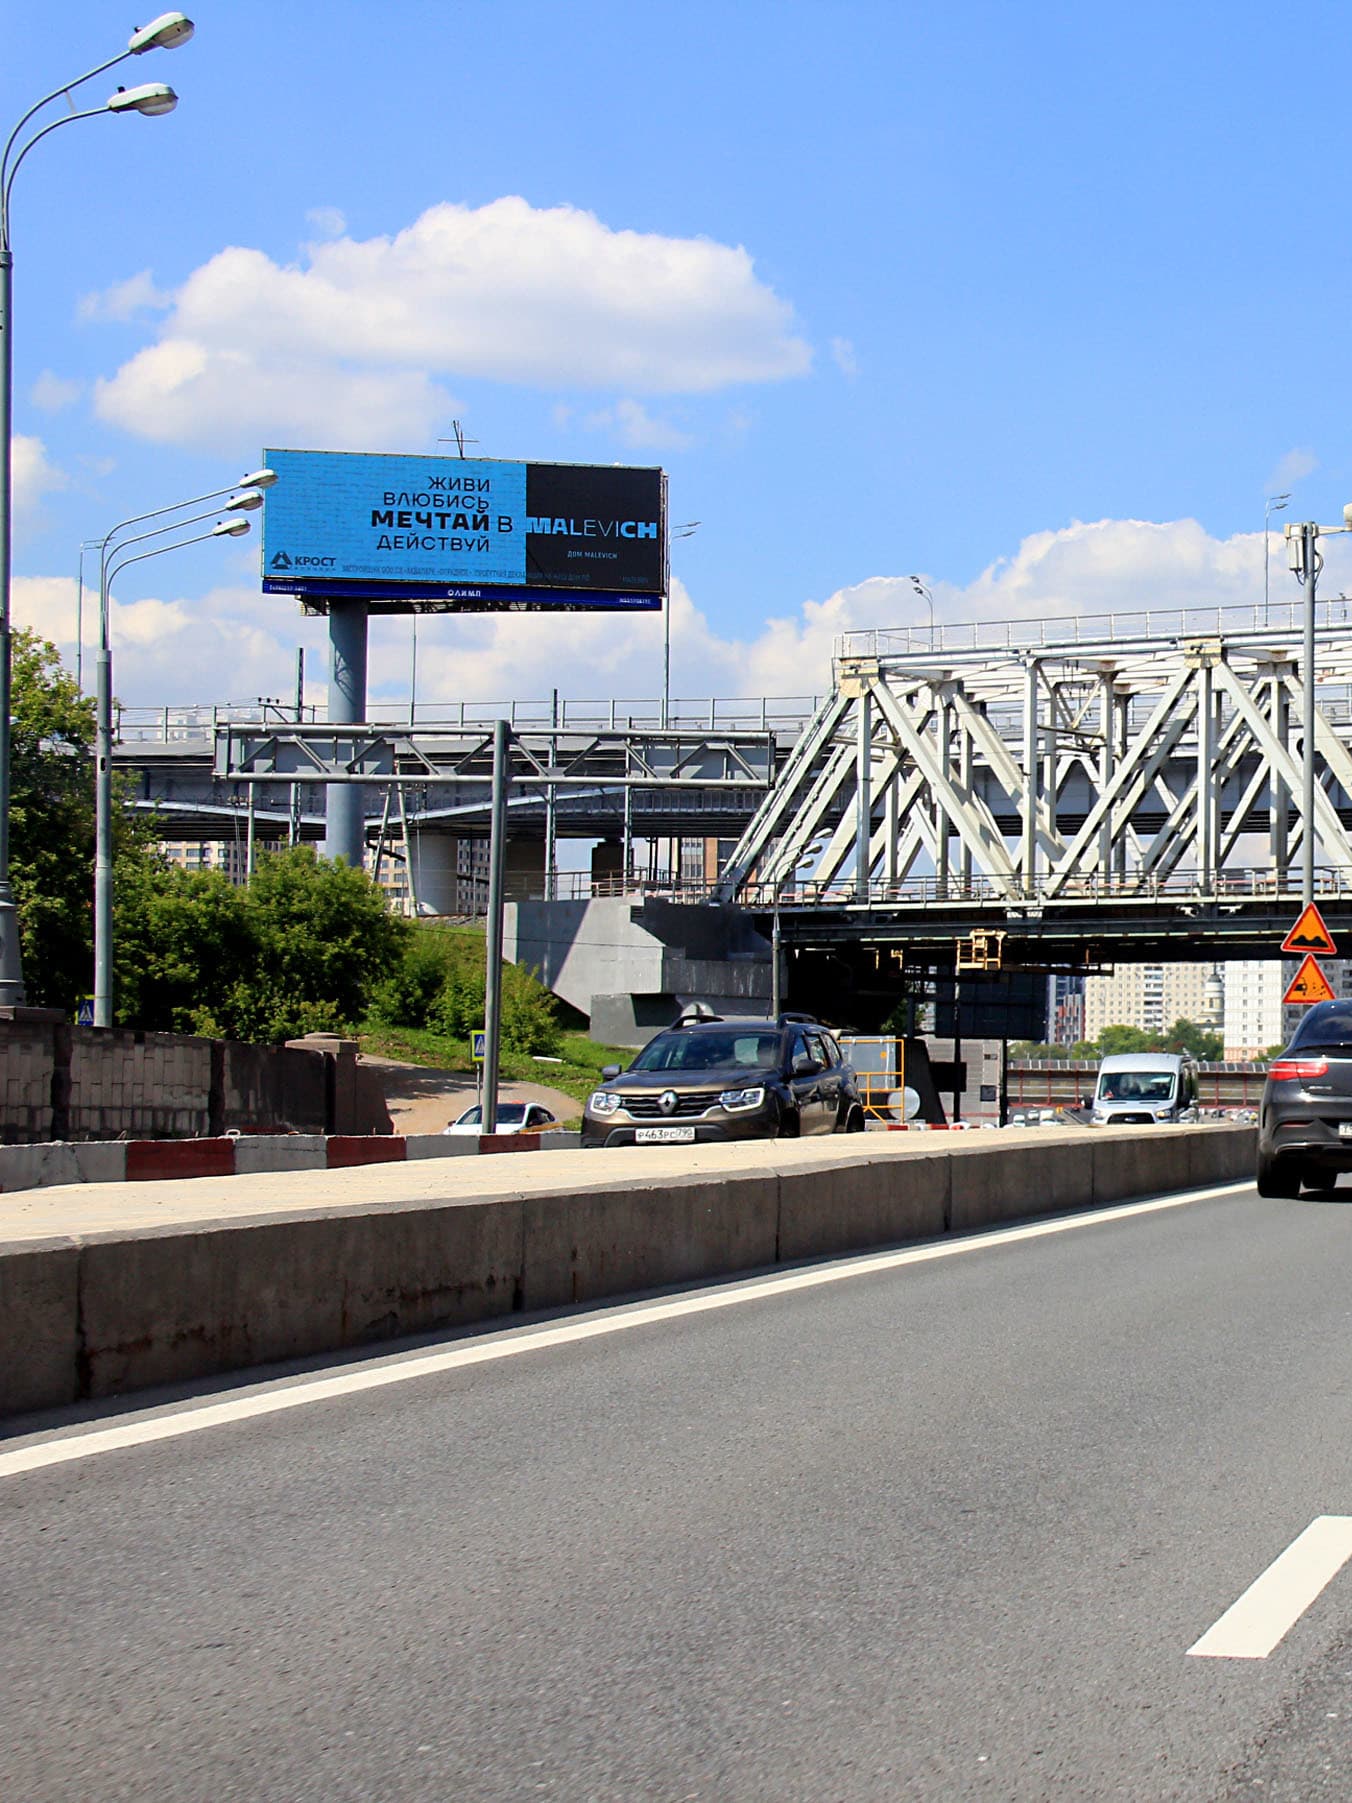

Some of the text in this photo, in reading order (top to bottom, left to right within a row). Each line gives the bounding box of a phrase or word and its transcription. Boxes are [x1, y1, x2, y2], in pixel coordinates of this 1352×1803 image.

[428, 476, 490, 492] ЖИВИ
[383, 492, 489, 510] ВЛЮБИСЬ
[371, 509, 658, 539] МЕЧТАЙ В MALEVICH
[376, 532, 489, 552] ДЕЙСТВУЙ
[294, 556, 337, 567] КРОСТ
[567, 550, 618, 560] ДОМ MALEVICH
[447, 589, 481, 598] ОЛИМП
